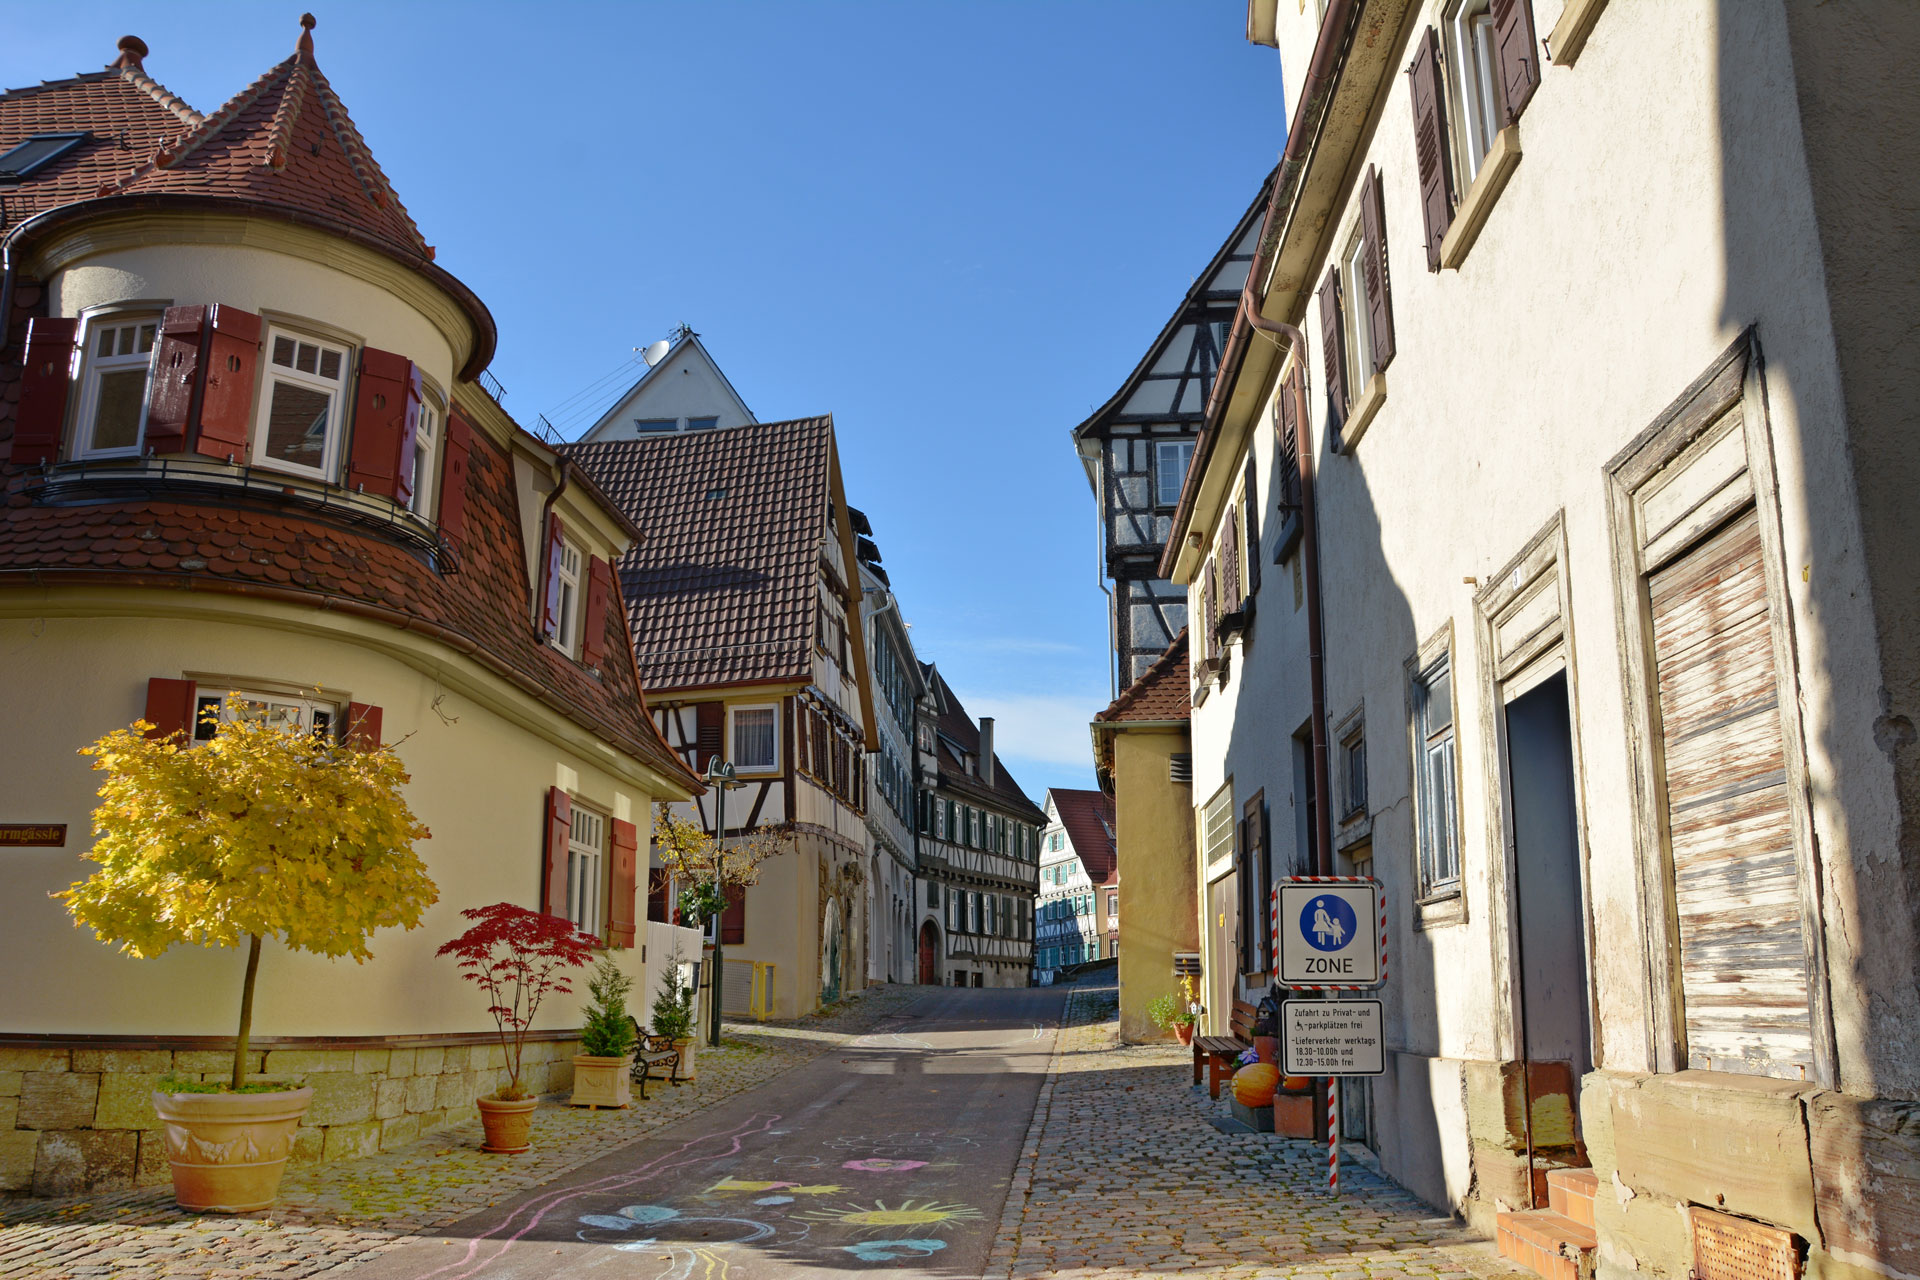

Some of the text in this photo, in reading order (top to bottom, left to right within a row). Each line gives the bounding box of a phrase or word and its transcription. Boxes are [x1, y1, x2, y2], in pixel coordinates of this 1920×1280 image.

[1305, 957, 1353, 974] ZONE
[1294, 1008, 1319, 1017] Zufahrt
[1332, 1008, 1357, 1017] Privat-
[1357, 1008, 1371, 1017] und
[1304, 1020, 1363, 1031] -parkplätzen frei
[1291, 1036, 1376, 1047] -Lieferverkehr werktags
[1340, 1047, 1354, 1056] und
[1341, 1057, 1354, 1067] frei
